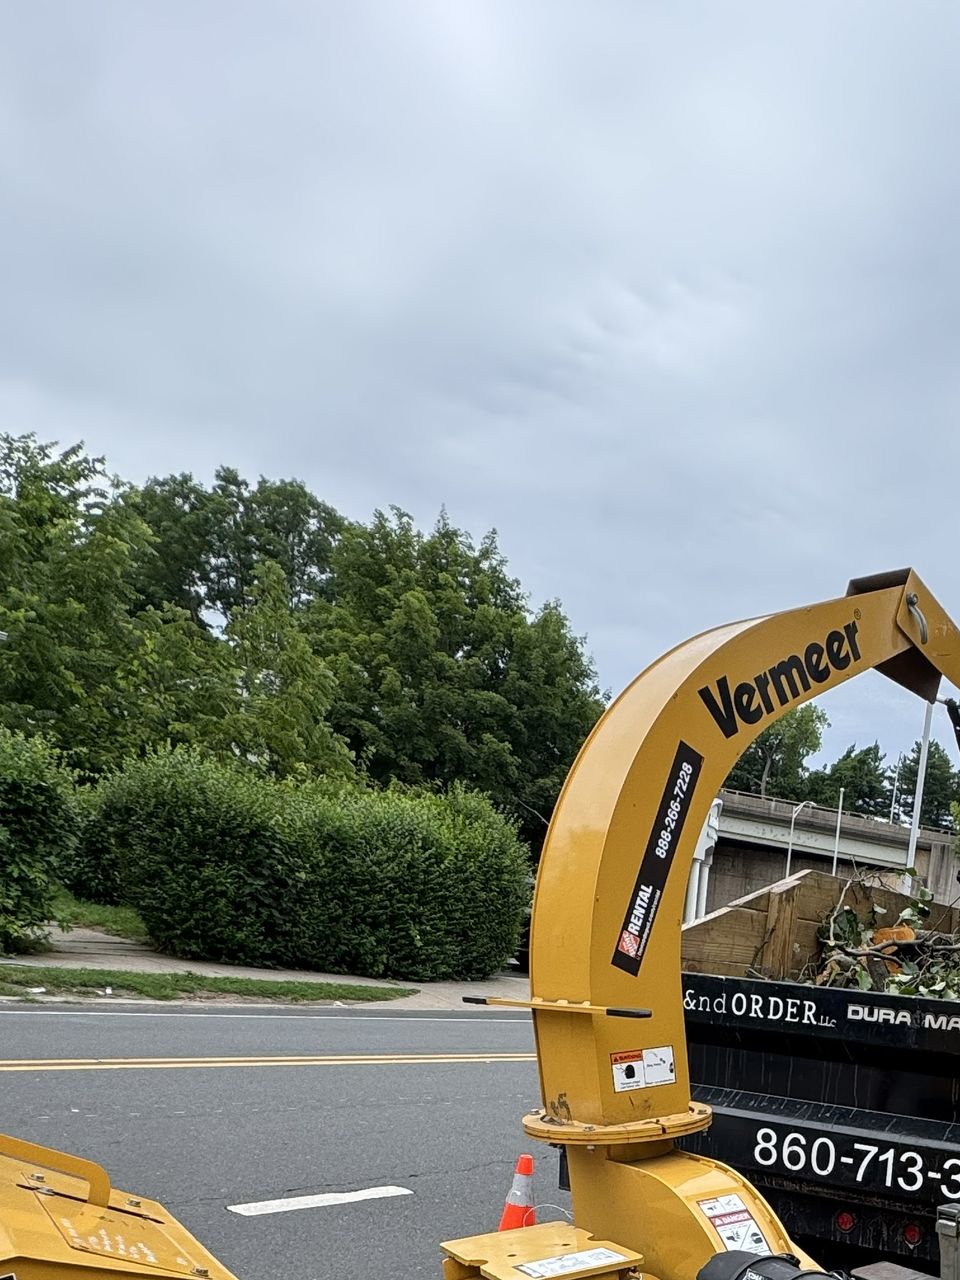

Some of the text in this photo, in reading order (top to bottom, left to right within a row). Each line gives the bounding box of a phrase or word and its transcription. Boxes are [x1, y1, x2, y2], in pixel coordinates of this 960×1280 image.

[697, 621, 862, 739] Vermeer
[655, 762, 693, 859] 888-266-7228
[627, 884, 653, 936] RENTAL
[731, 992, 817, 1025] ORDER
[847, 1005, 911, 1026] DURA
